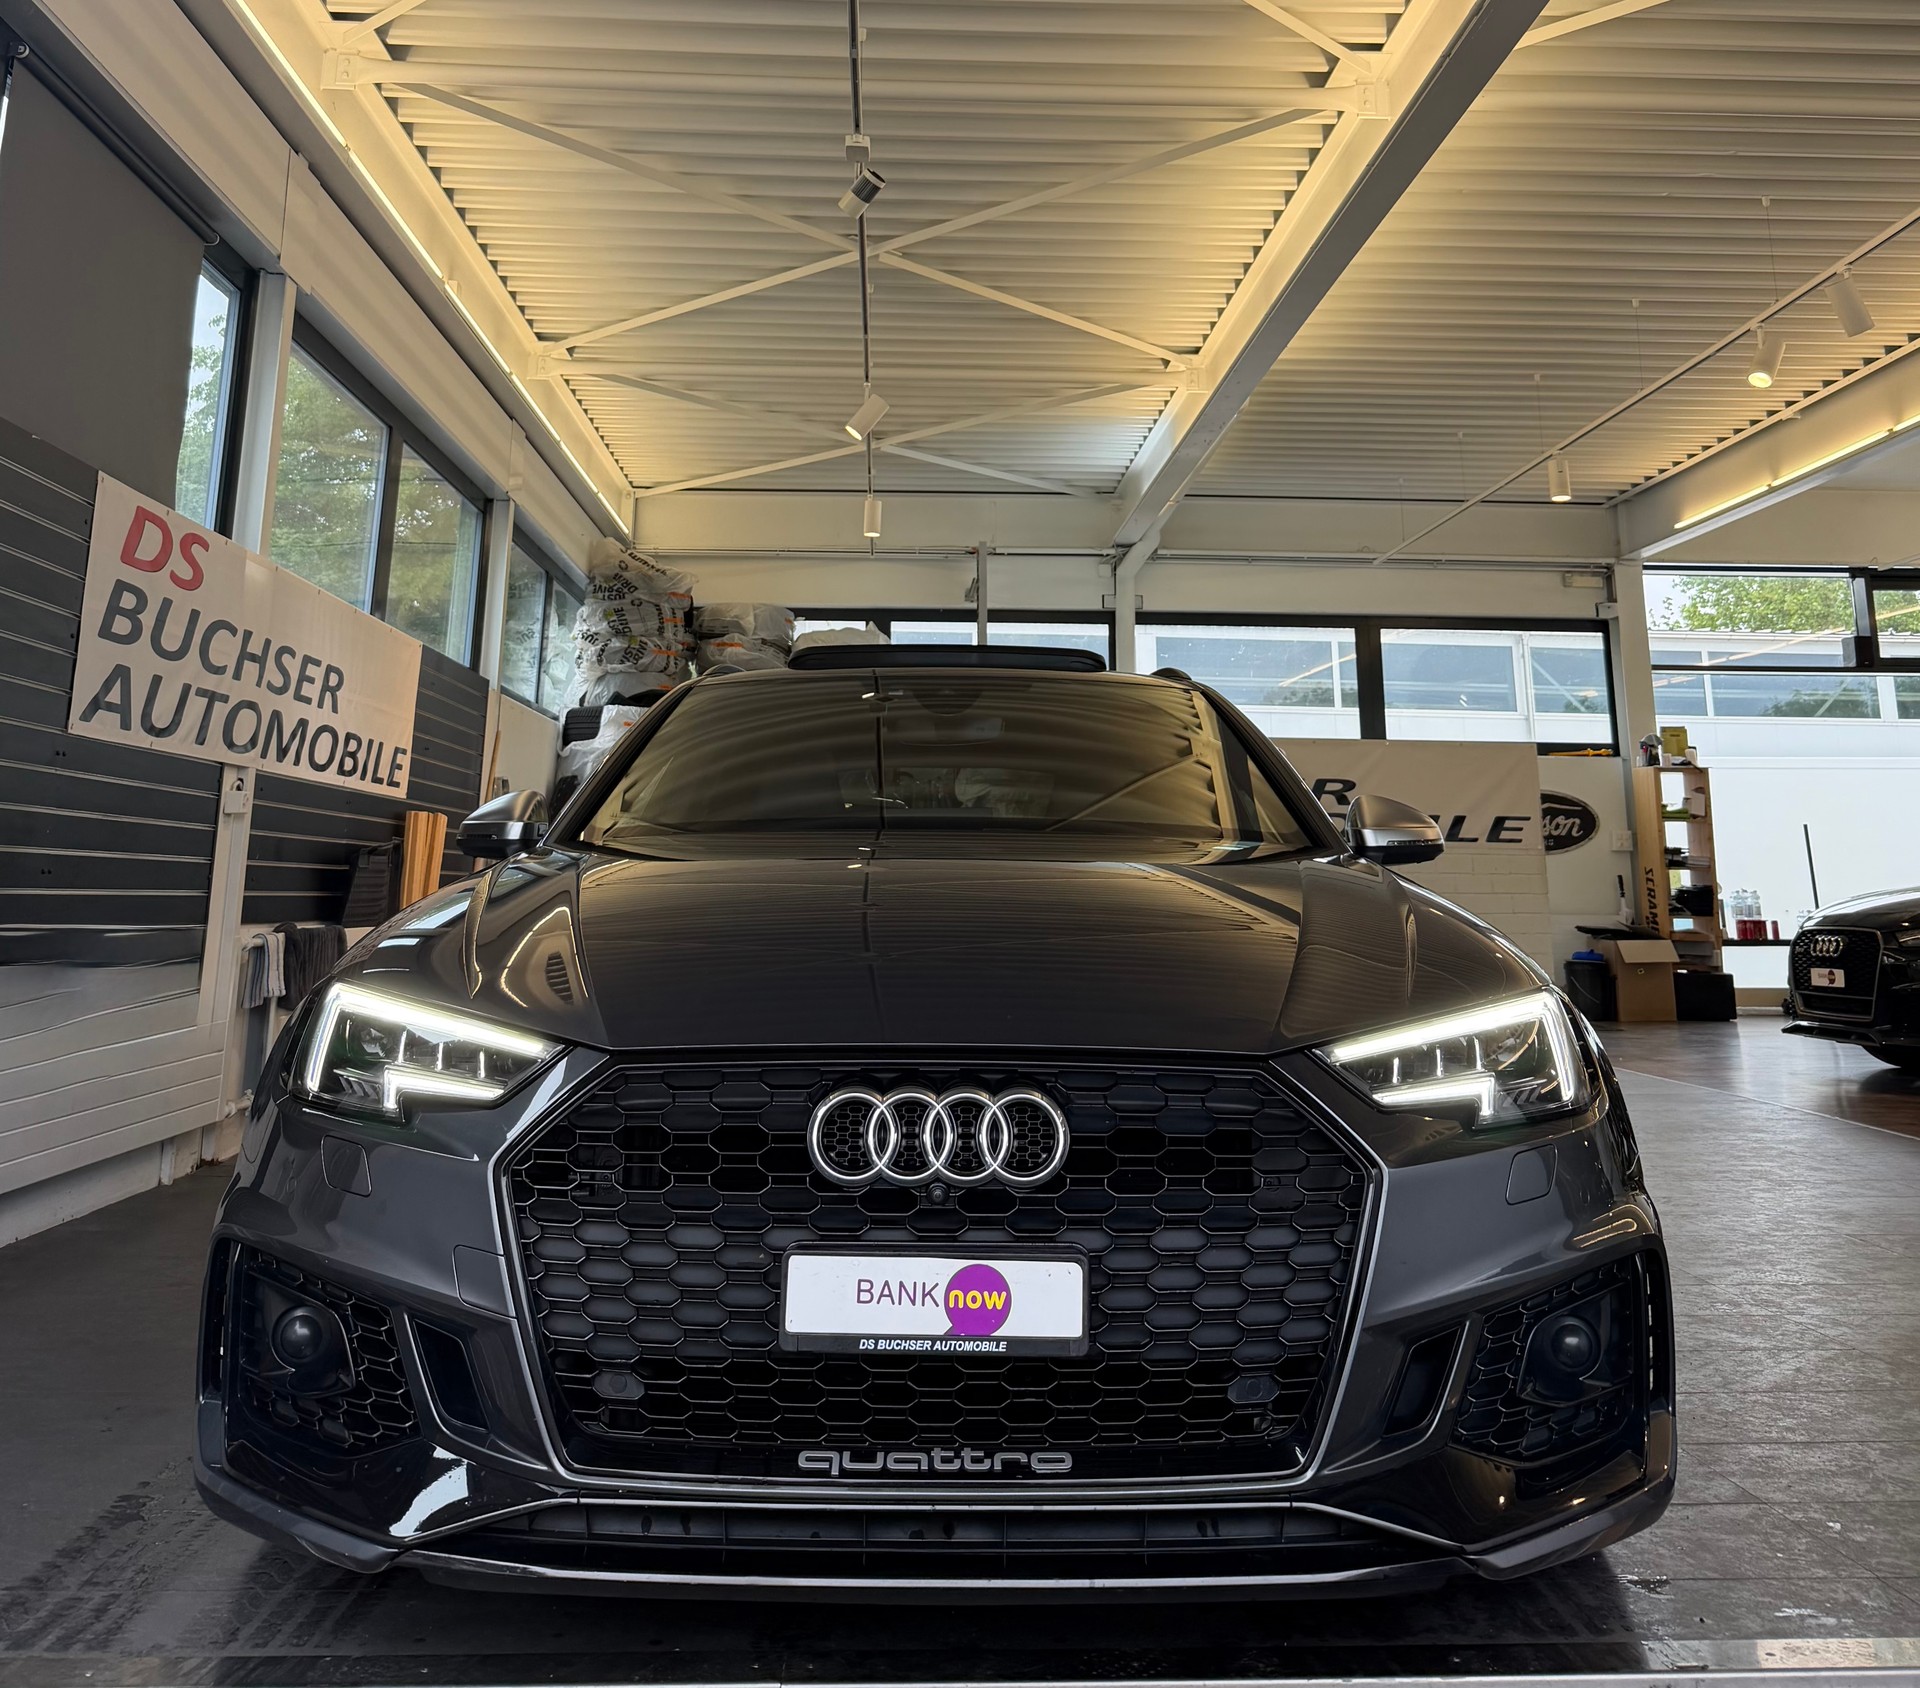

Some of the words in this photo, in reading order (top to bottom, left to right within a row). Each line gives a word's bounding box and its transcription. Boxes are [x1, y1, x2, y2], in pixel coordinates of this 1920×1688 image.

[119, 505, 210, 592] DS
[97, 578, 346, 714] BUCHSER
[78, 663, 408, 789] AUTOMOBILE
[856, 1279, 940, 1308] BANK
[949, 1289, 1007, 1310] now
[859, 1339, 876, 1350] DS
[877, 1339, 932, 1351] BUCHSER
[933, 1340, 1008, 1352] AUTOMOBILE
[798, 1447, 1073, 1477] quattro
